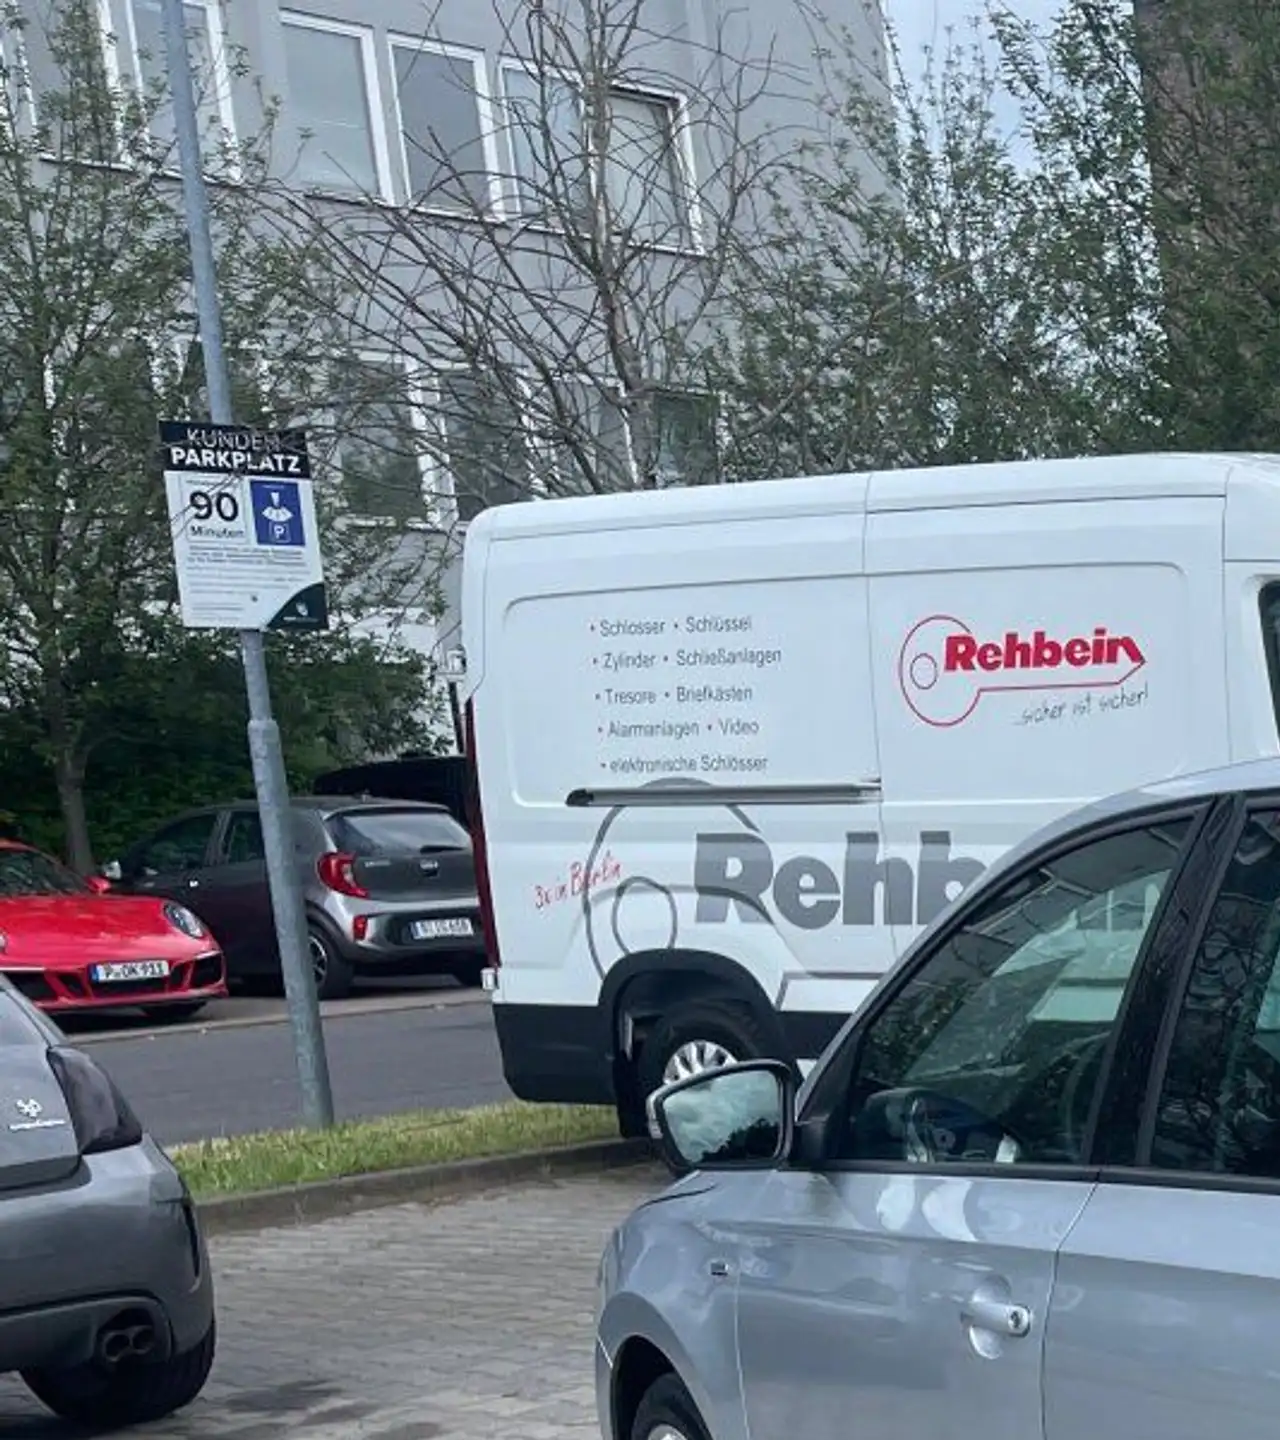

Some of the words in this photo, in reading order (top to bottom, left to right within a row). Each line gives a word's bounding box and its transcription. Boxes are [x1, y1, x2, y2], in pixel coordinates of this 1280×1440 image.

[170, 446, 301, 472] PARKPLATZ
[189, 491, 239, 522] 90
[603, 652, 656, 671] Zylinder
[944, 628, 1147, 672] Rehbein
[605, 688, 657, 704] Tresore
[607, 721, 700, 739] Alarmanlagen
[718, 718, 760, 735] Video
[610, 758, 697, 774] elektronische
[695, 831, 988, 930] Rehb
